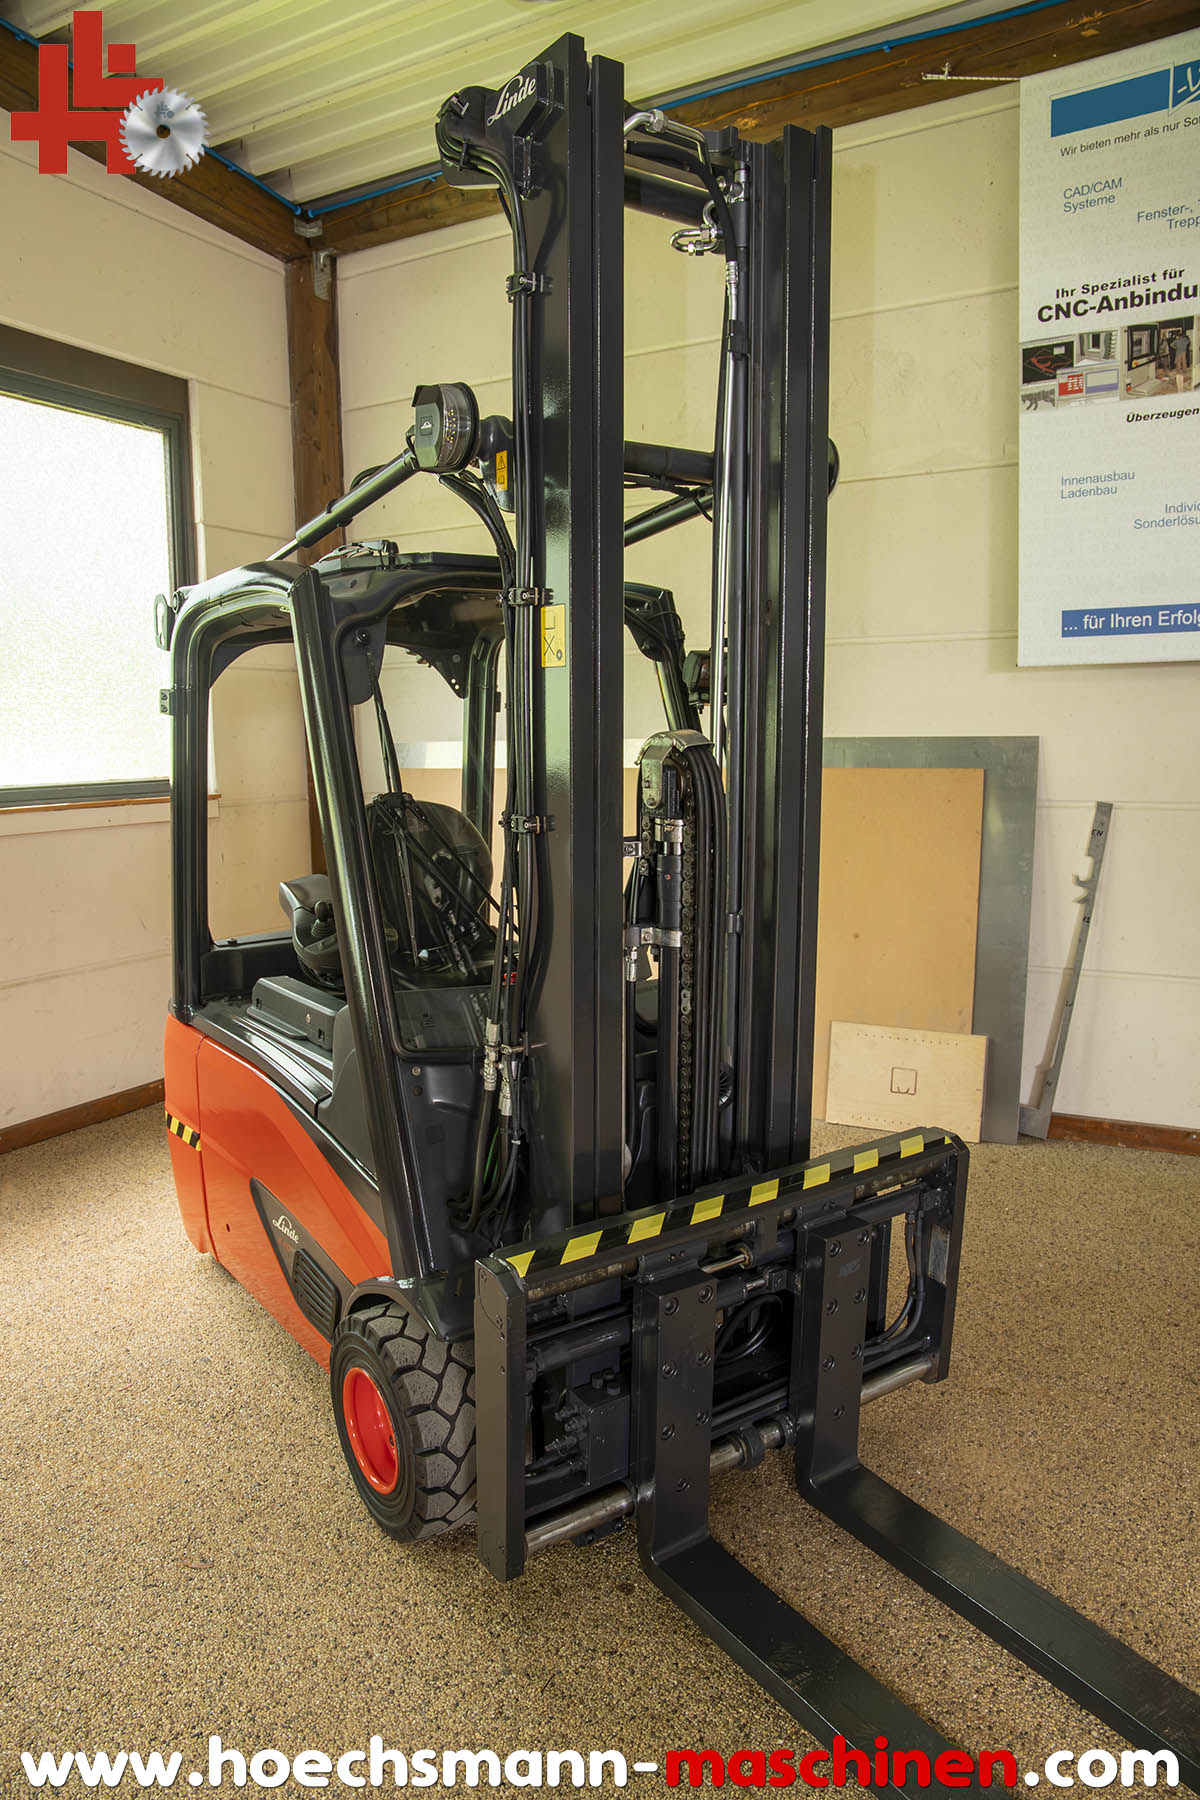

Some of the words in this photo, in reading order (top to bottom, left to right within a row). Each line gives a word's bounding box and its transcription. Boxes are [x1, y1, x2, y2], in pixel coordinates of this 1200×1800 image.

[487, 75, 536, 126] Linde
[1060, 145, 1077, 157] Wir
[1080, 139, 1111, 153] bieten
[1114, 132, 1141, 145] mehr
[1144, 127, 1160, 138] als
[1162, 121, 1180, 133] nur
[1064, 177, 1123, 199] CAD/CAM
[1063, 195, 1116, 214] Systeme
[1056, 287, 1076, 299] Ihr
[1081, 272, 1157, 296] Spezialist
[1162, 267, 1185, 280] für
[1061, 471, 1135, 486] Innenausbau
[1060, 485, 1118, 500] Ladenbau
[1083, 614, 1105, 630] für
[1110, 612, 1152, 629] Ihren
[272, 1215, 299, 1244] Linde
